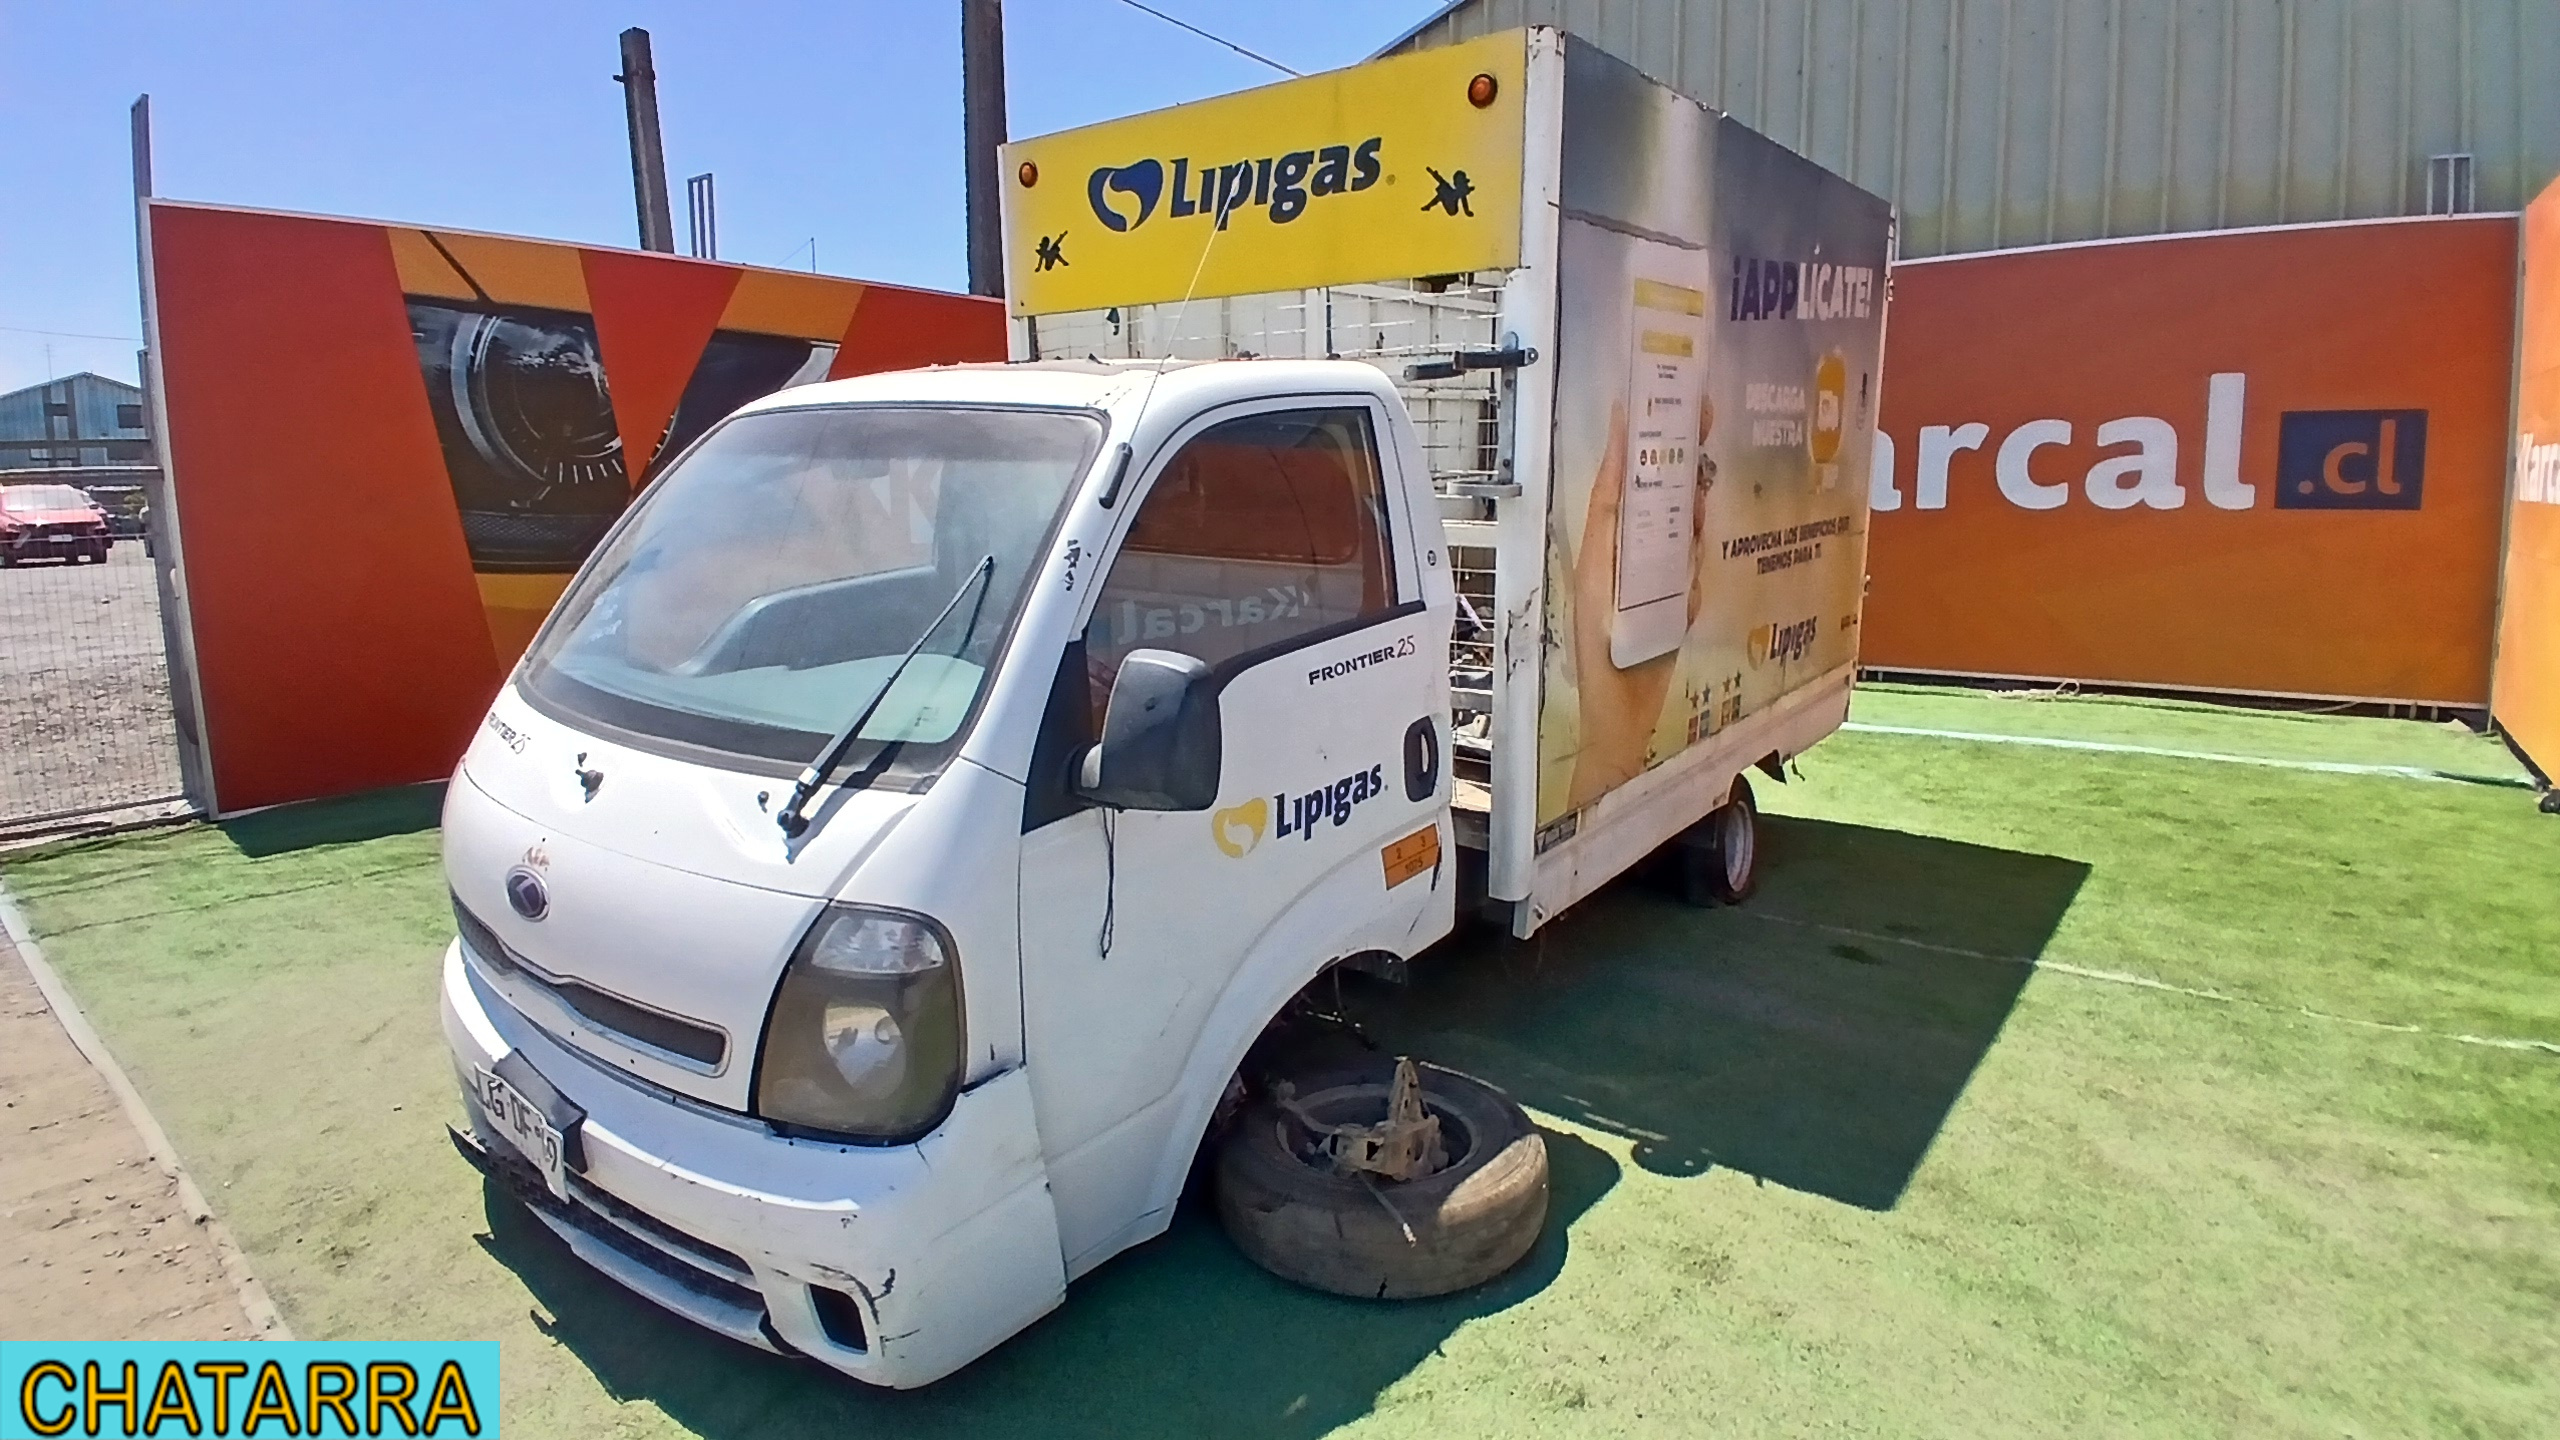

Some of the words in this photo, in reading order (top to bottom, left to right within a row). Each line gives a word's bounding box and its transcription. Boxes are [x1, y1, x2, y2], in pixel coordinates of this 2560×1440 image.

[1170, 136, 1382, 231] Lipigas
[1752, 419, 1803, 447] NUESTRA
[2298, 418, 2401, 495] .cl
[1721, 540, 1729, 560] Y
[1308, 645, 1396, 685] FRONTIER
[1396, 634, 1416, 657] 25
[1769, 615, 1818, 668] Lipigas
[1273, 763, 1384, 841] Lipigas
